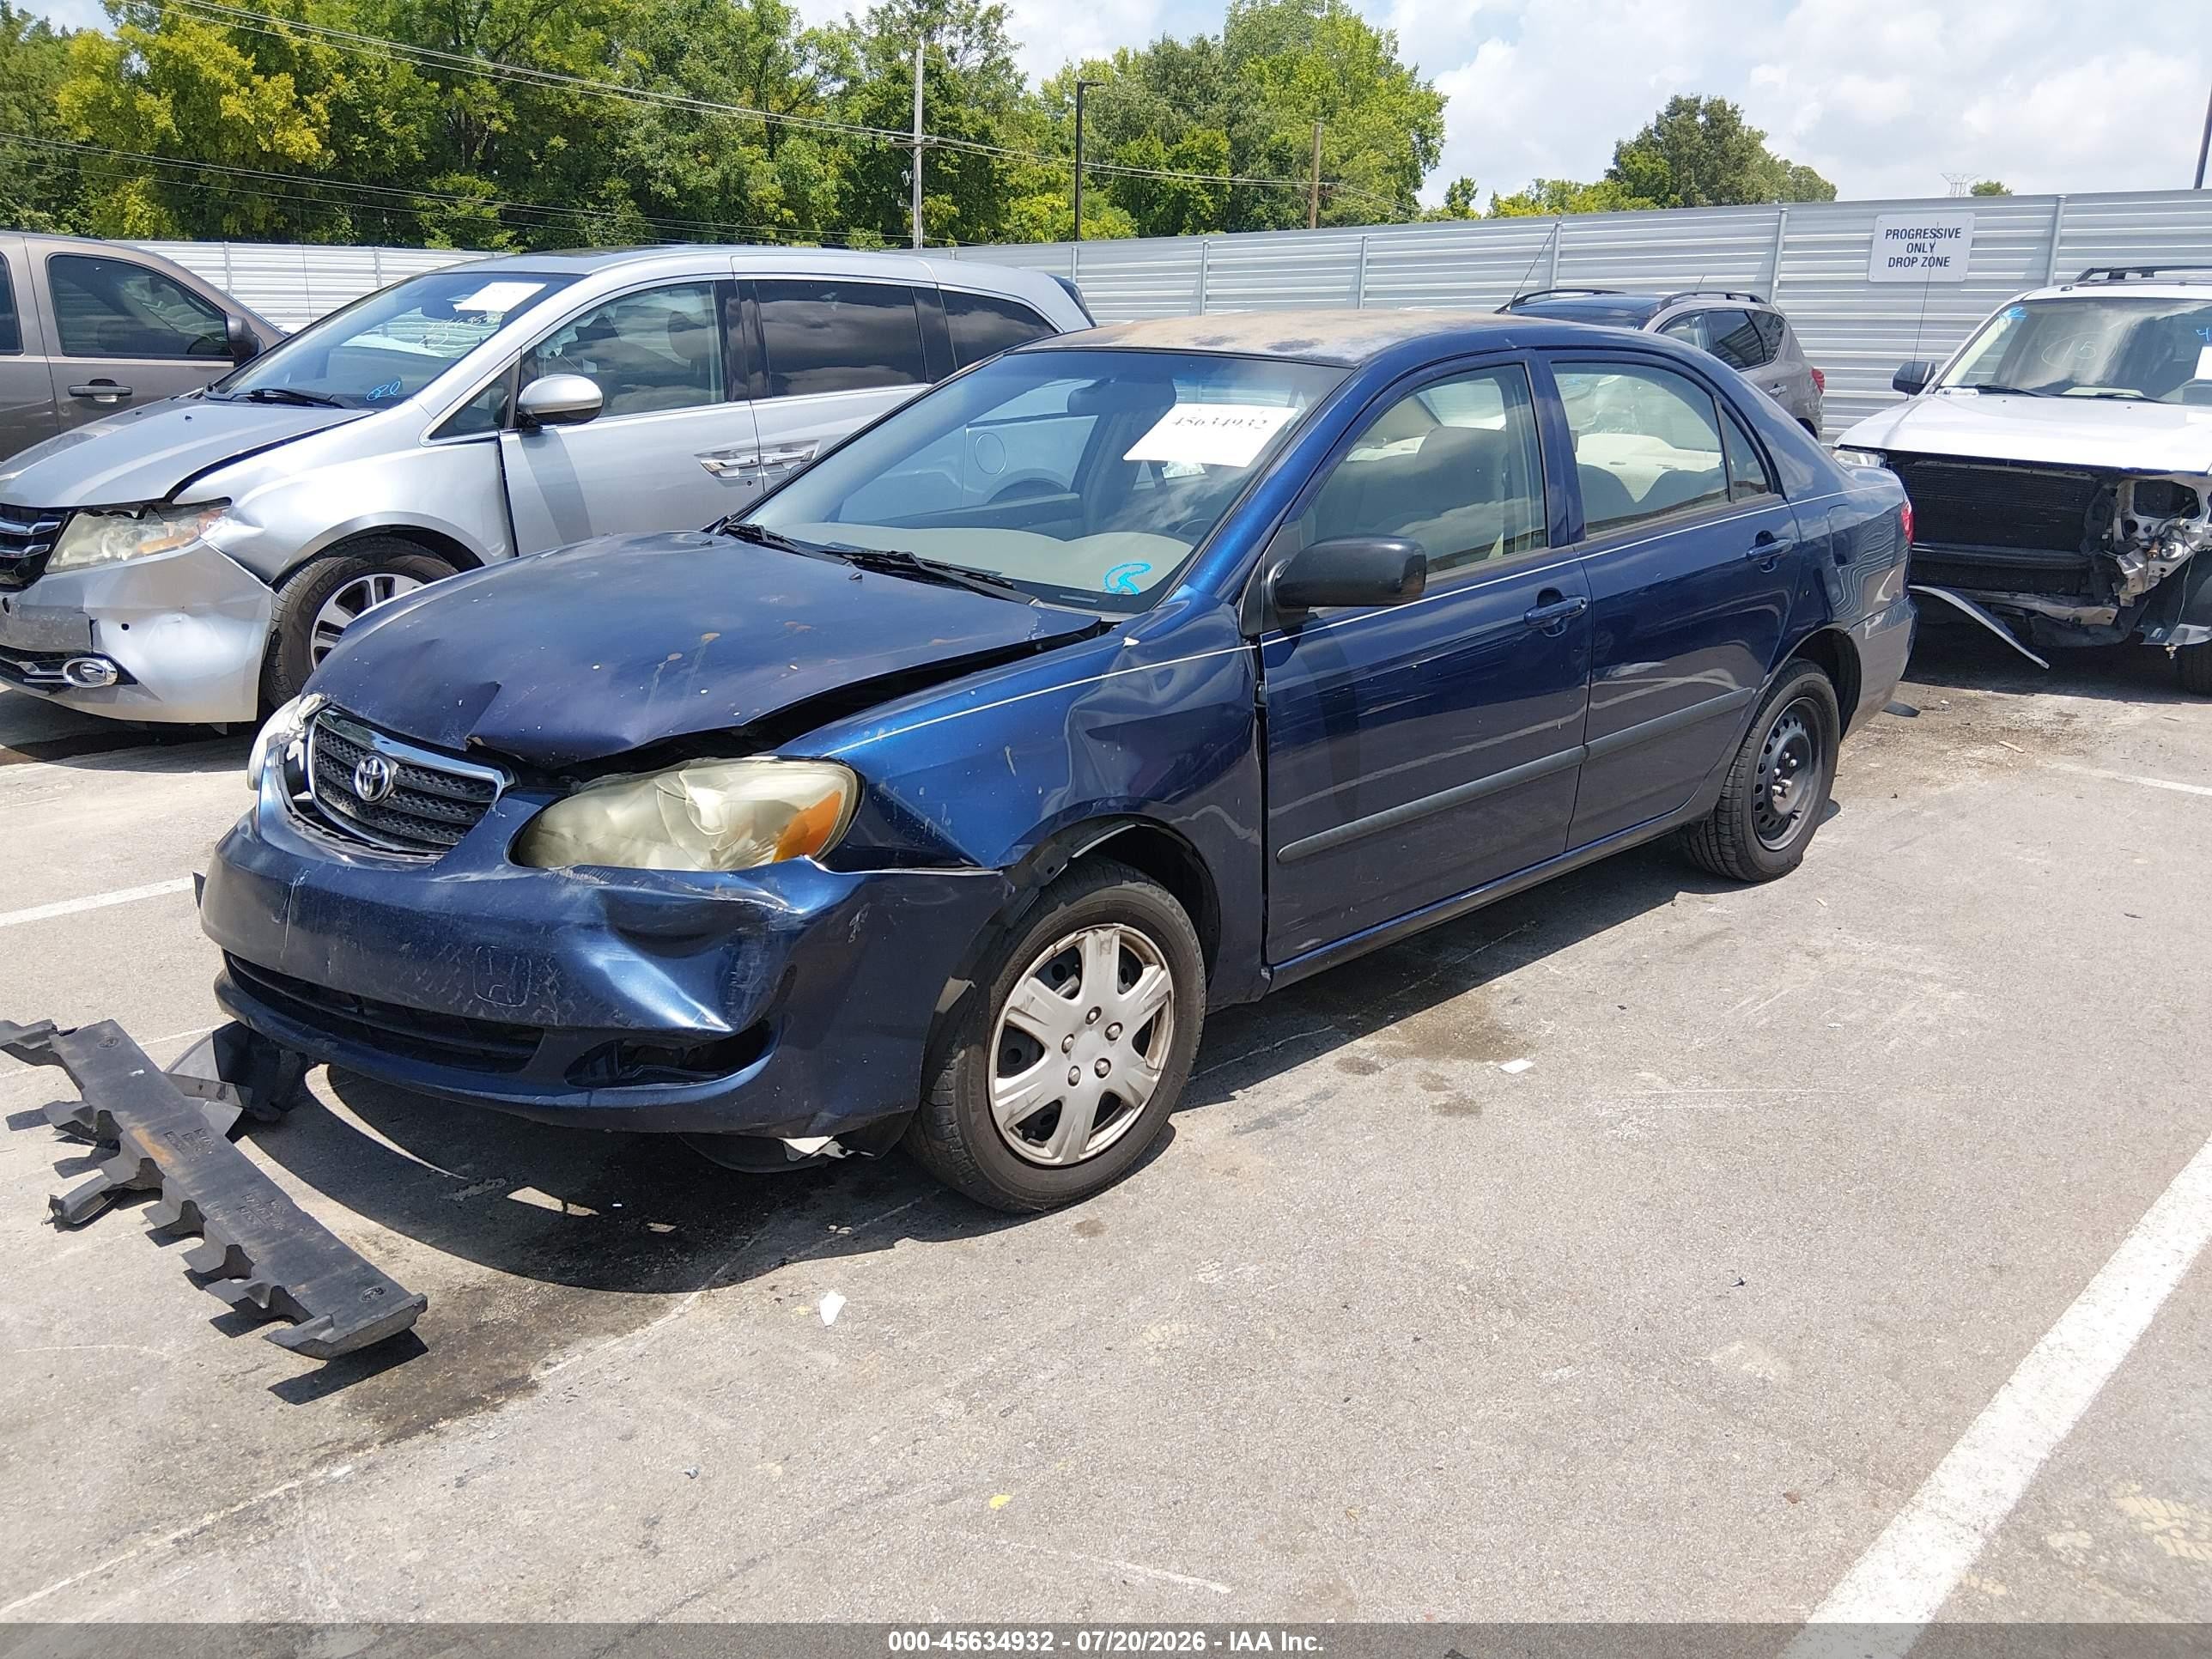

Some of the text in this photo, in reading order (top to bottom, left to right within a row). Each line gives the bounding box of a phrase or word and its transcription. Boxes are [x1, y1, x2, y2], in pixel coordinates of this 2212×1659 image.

[1886, 228, 1961, 240] PROGRESSIVE
[1906, 243, 1936, 253] ONLY
[1888, 257, 1950, 267] DROP ZONE
